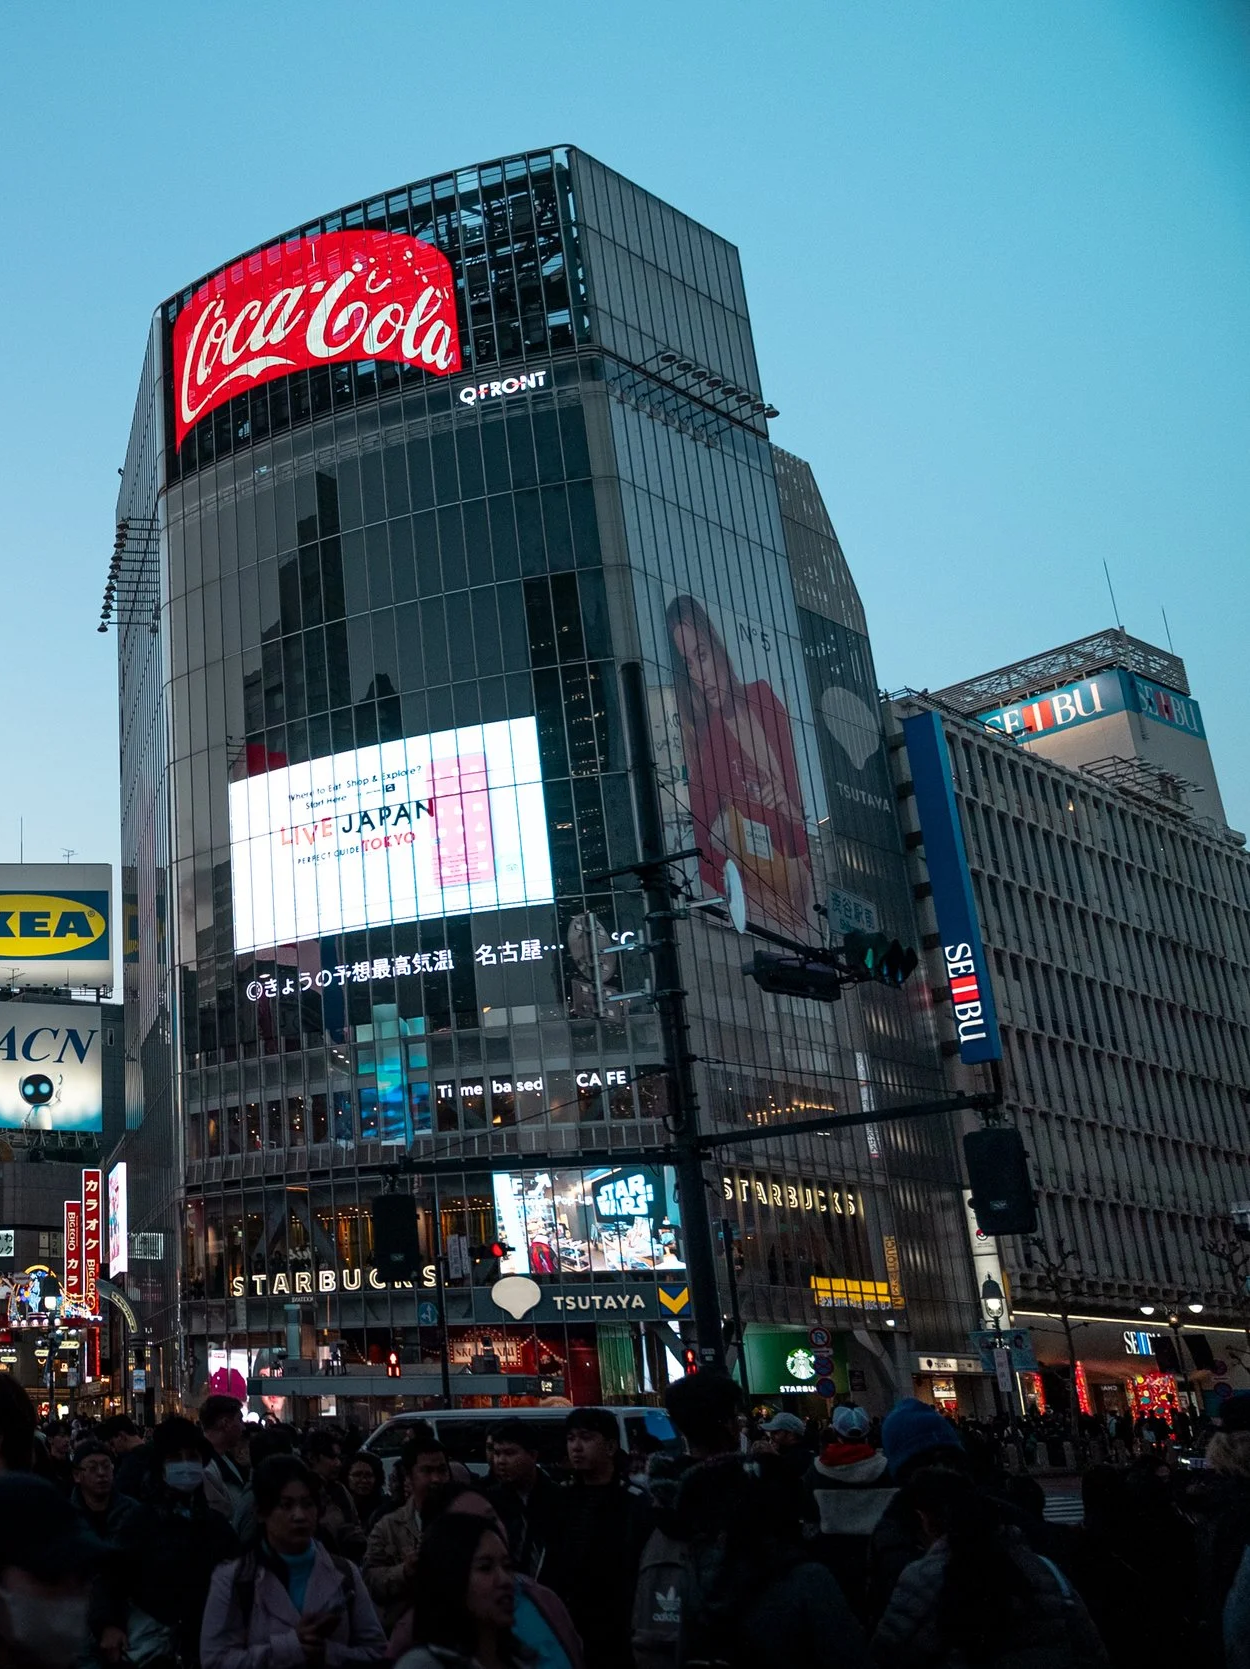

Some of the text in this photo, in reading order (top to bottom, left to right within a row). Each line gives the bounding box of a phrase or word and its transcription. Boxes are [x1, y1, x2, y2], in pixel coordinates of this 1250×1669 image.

[182, 266, 454, 424] Coca-Cola
[984, 682, 1105, 737] SEIBU
[1135, 682, 1199, 735] SEIBU
[835, 781, 892, 813] TSUTAYA
[280, 798, 435, 846] LIVE JAPAN
[362, 831, 416, 852] TOKYO
[264, 949, 455, 999] きょうの予想最高気温
[944, 942, 986, 1044] SEIBU
[437, 1069, 628, 1099] Time based CAFE
[596, 1196, 648, 1216] WARS
[599, 1174, 647, 1200] STAR
[723, 1177, 856, 1216] STARBUCKS
[85, 1179, 99, 1251] カラオケ
[67, 1257, 79, 1300] カラ
[552, 1294, 646, 1311] TSUTAYA
[1123, 1331, 1161, 1356] SEI
[652, 1610, 681, 1624] adida
